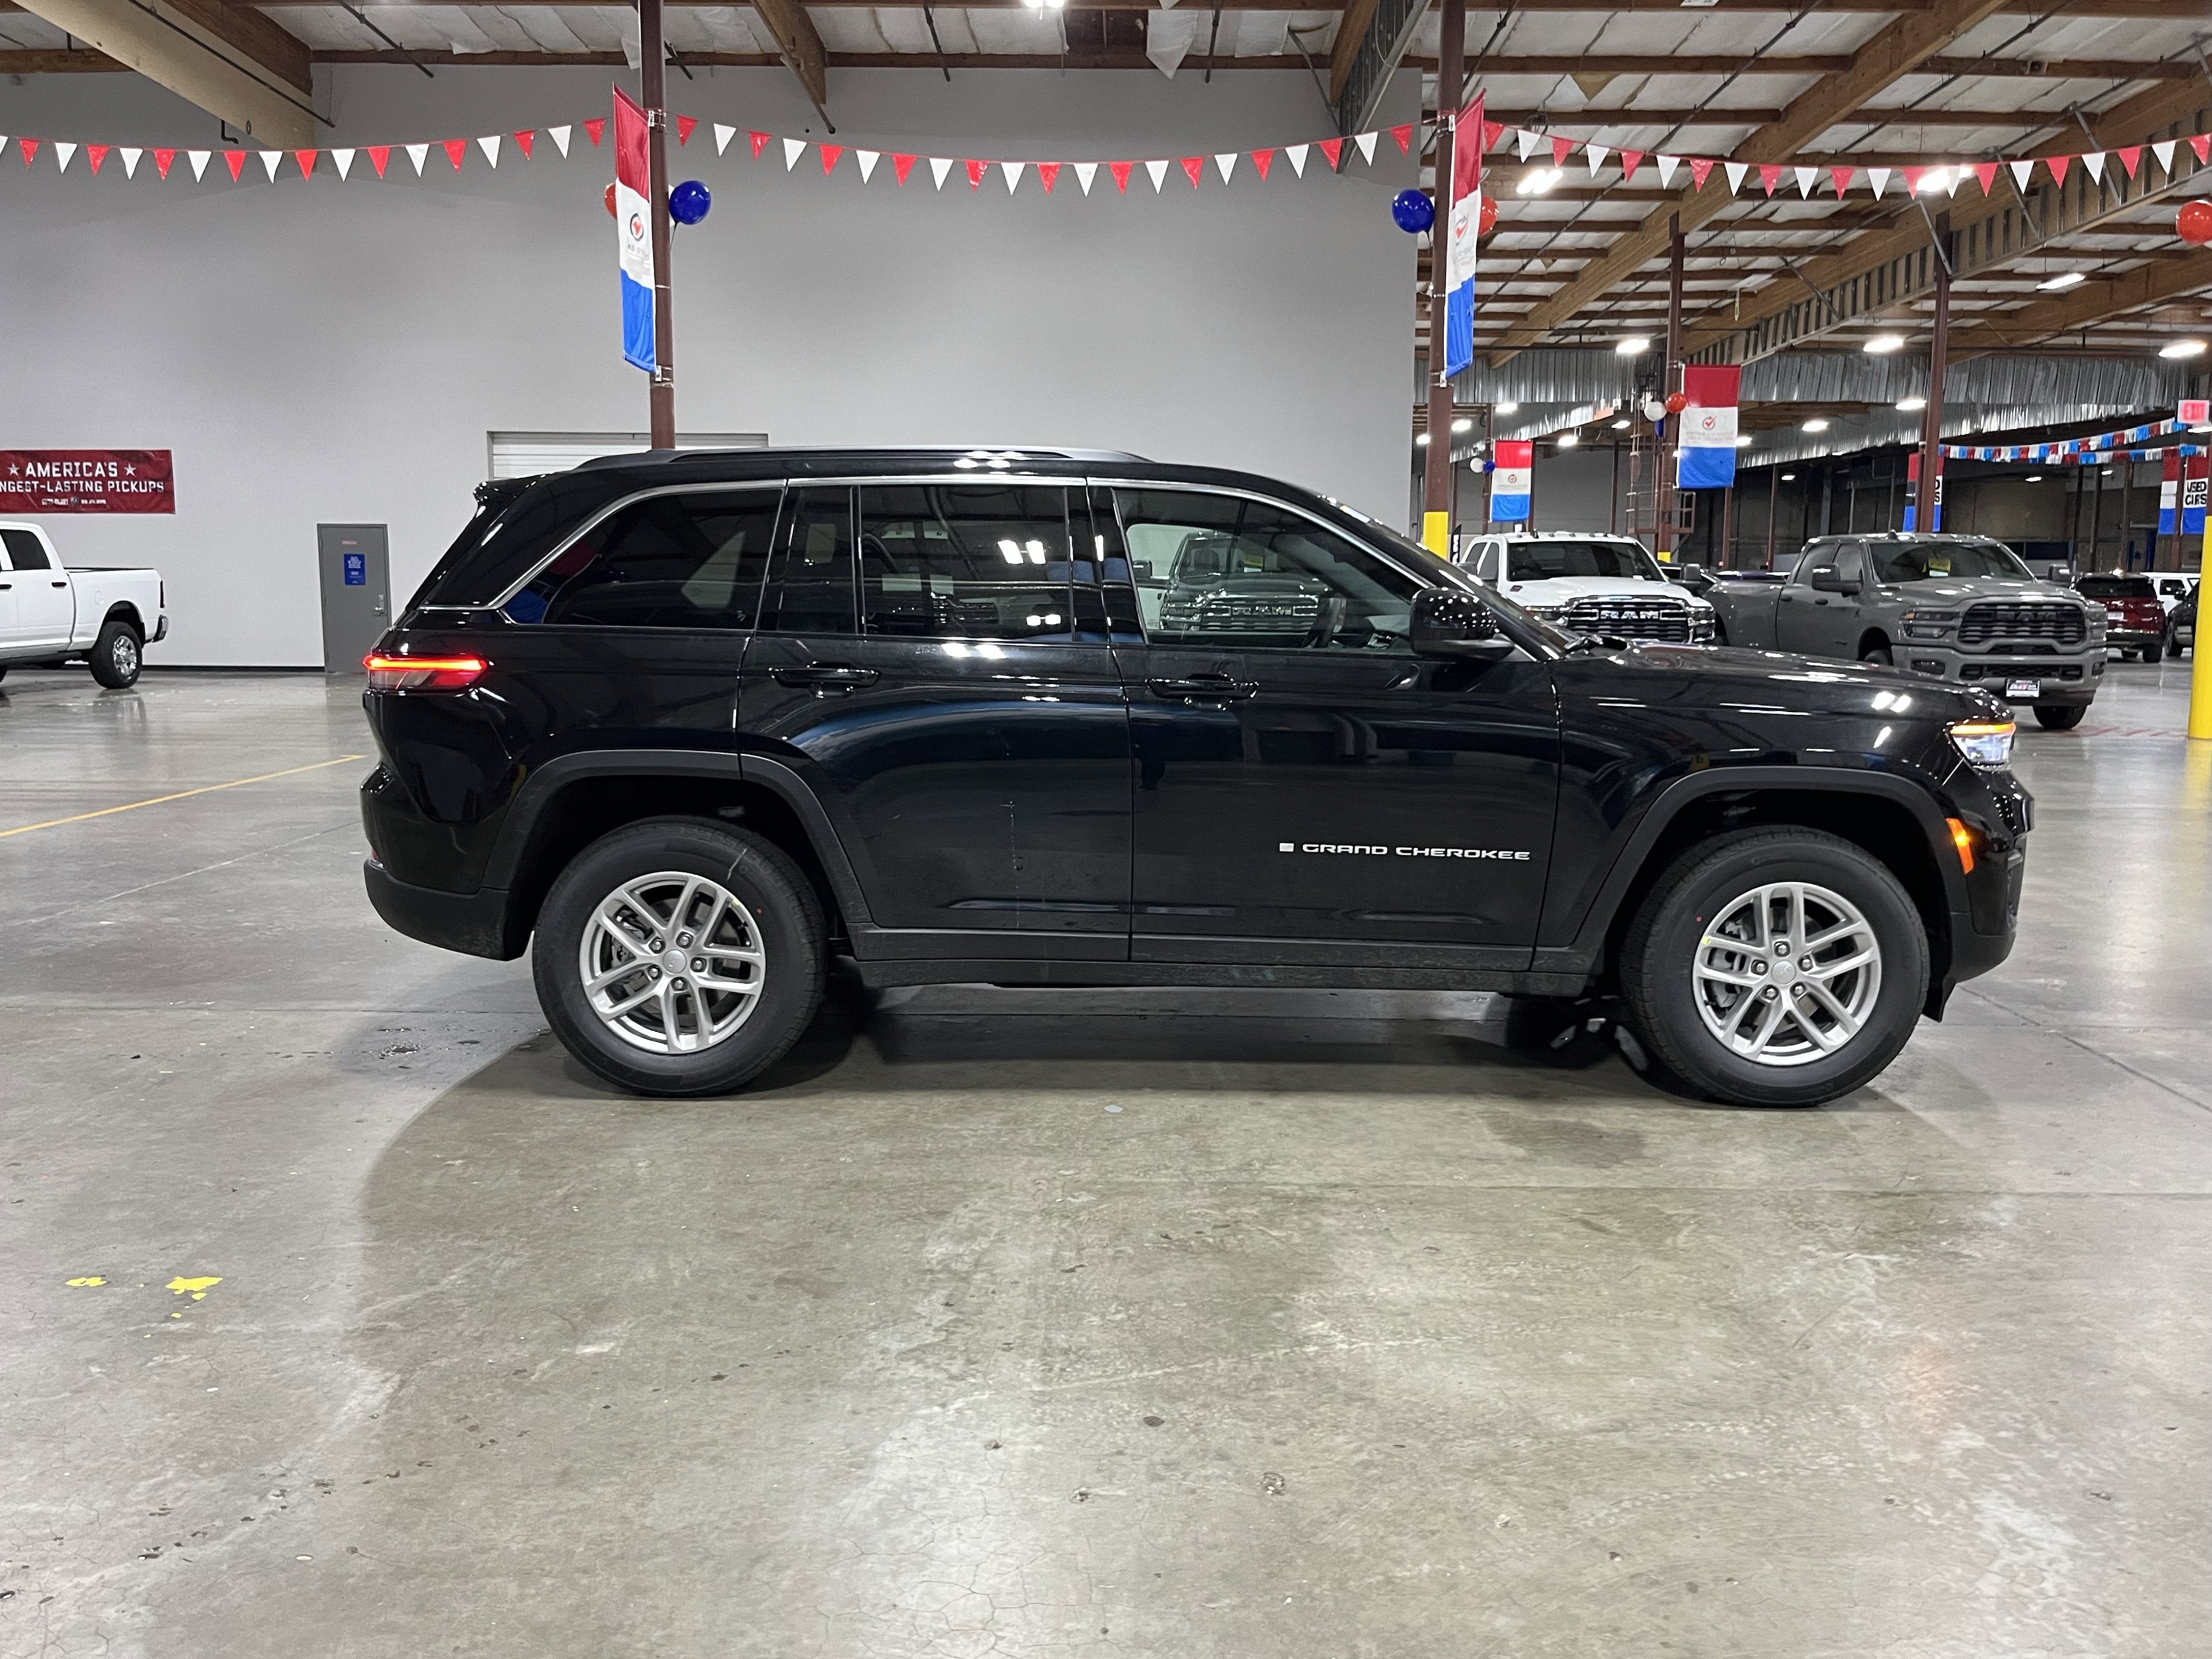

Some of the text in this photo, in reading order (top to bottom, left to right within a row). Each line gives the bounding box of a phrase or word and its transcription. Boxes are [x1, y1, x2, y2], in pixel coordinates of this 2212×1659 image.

[25, 462, 118, 477] AMERICA'S
[108, 481, 165, 493] PICKUPS
[2187, 481, 2207, 493] USED
[1600, 610, 1659, 620] RAM
[1302, 843, 1531, 860] GRAND CHEROKEE
